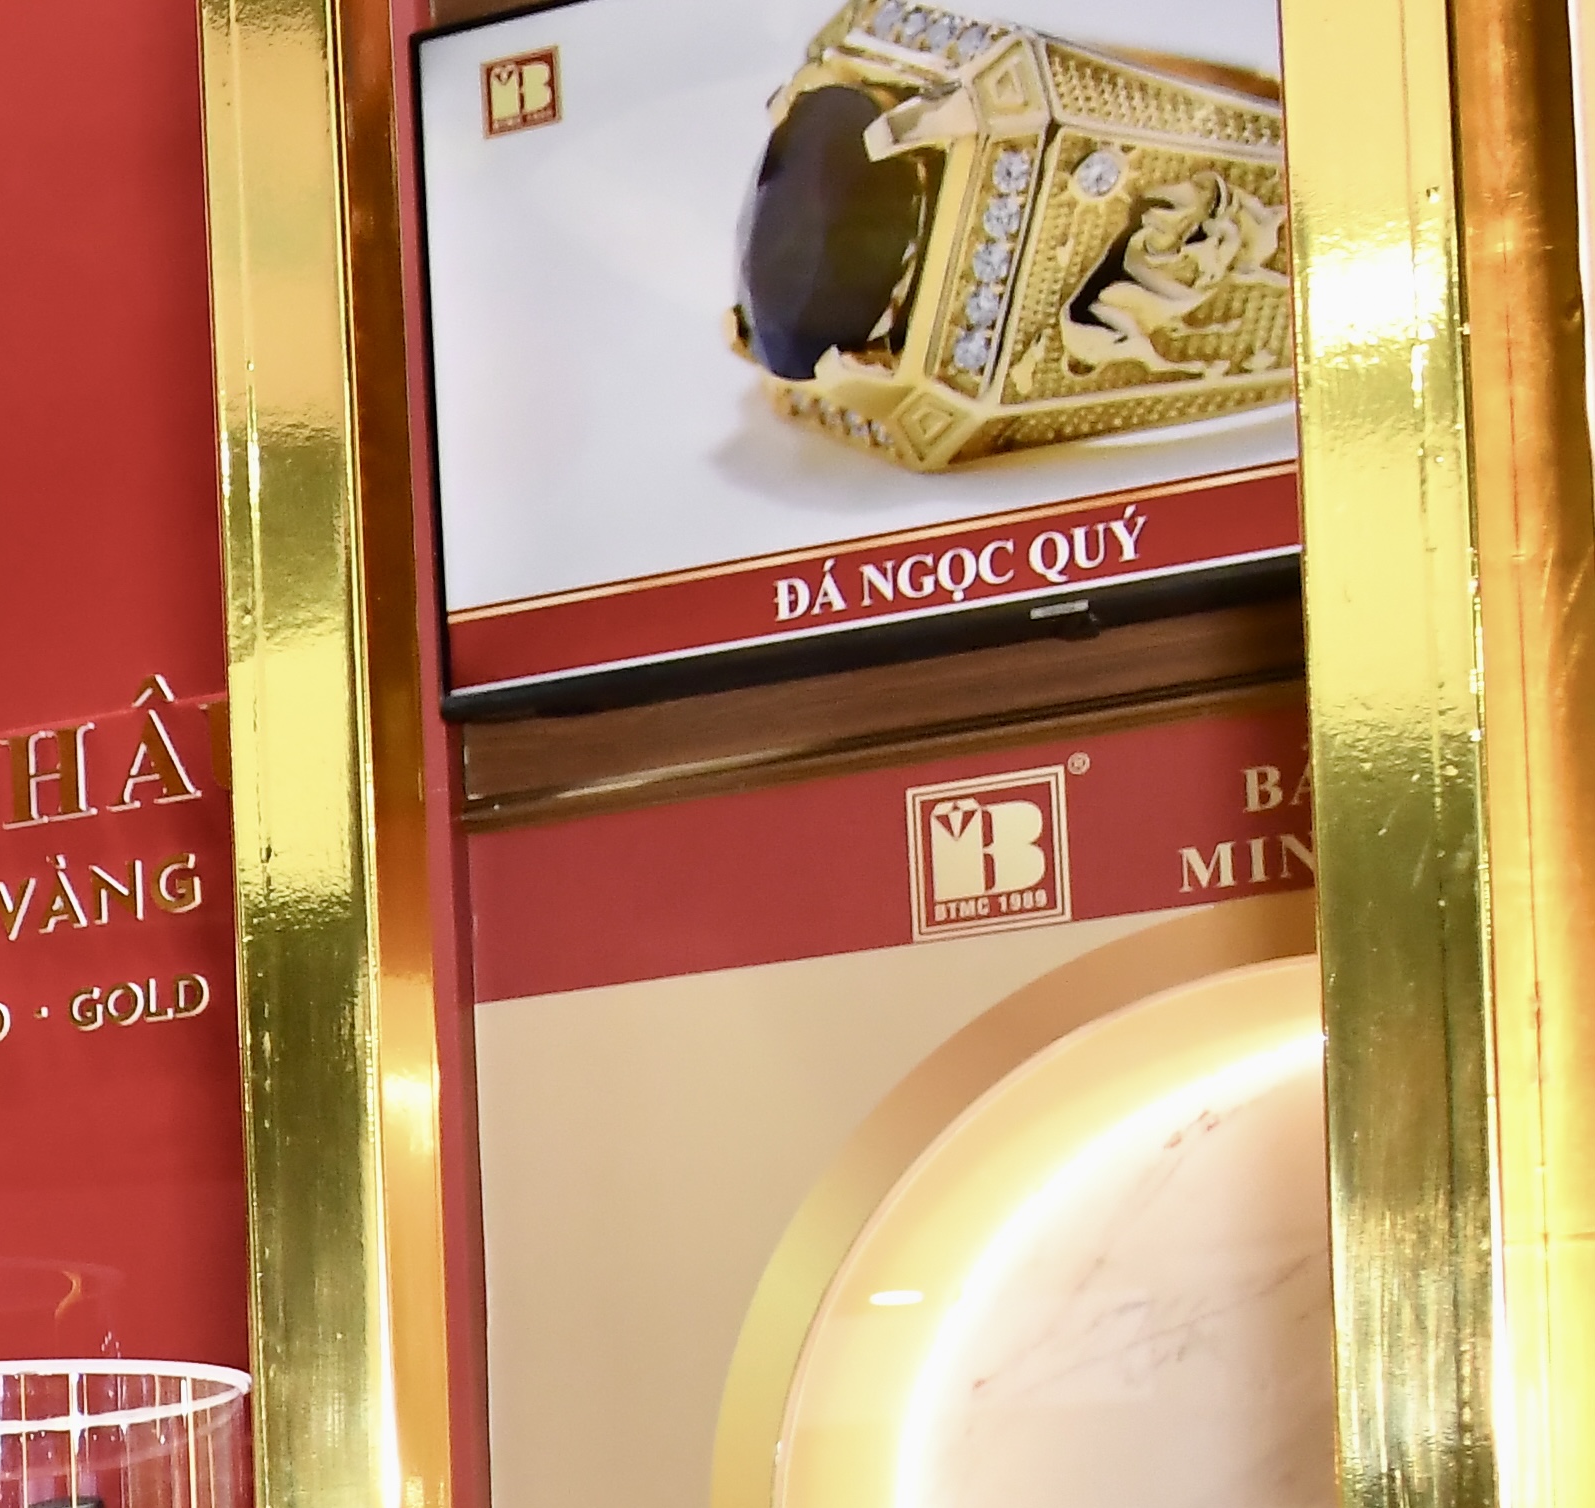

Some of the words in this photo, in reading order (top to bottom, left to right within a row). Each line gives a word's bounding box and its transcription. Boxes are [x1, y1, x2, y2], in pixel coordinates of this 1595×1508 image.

[772, 560, 848, 624] ĐÁ
[859, 539, 1016, 601] NGỌC
[1028, 505, 1148, 583] QUÝ
[1178, 832, 1317, 893] MIN
[933, 897, 991, 923] BTMC
[69, 973, 211, 1031] GOLD
